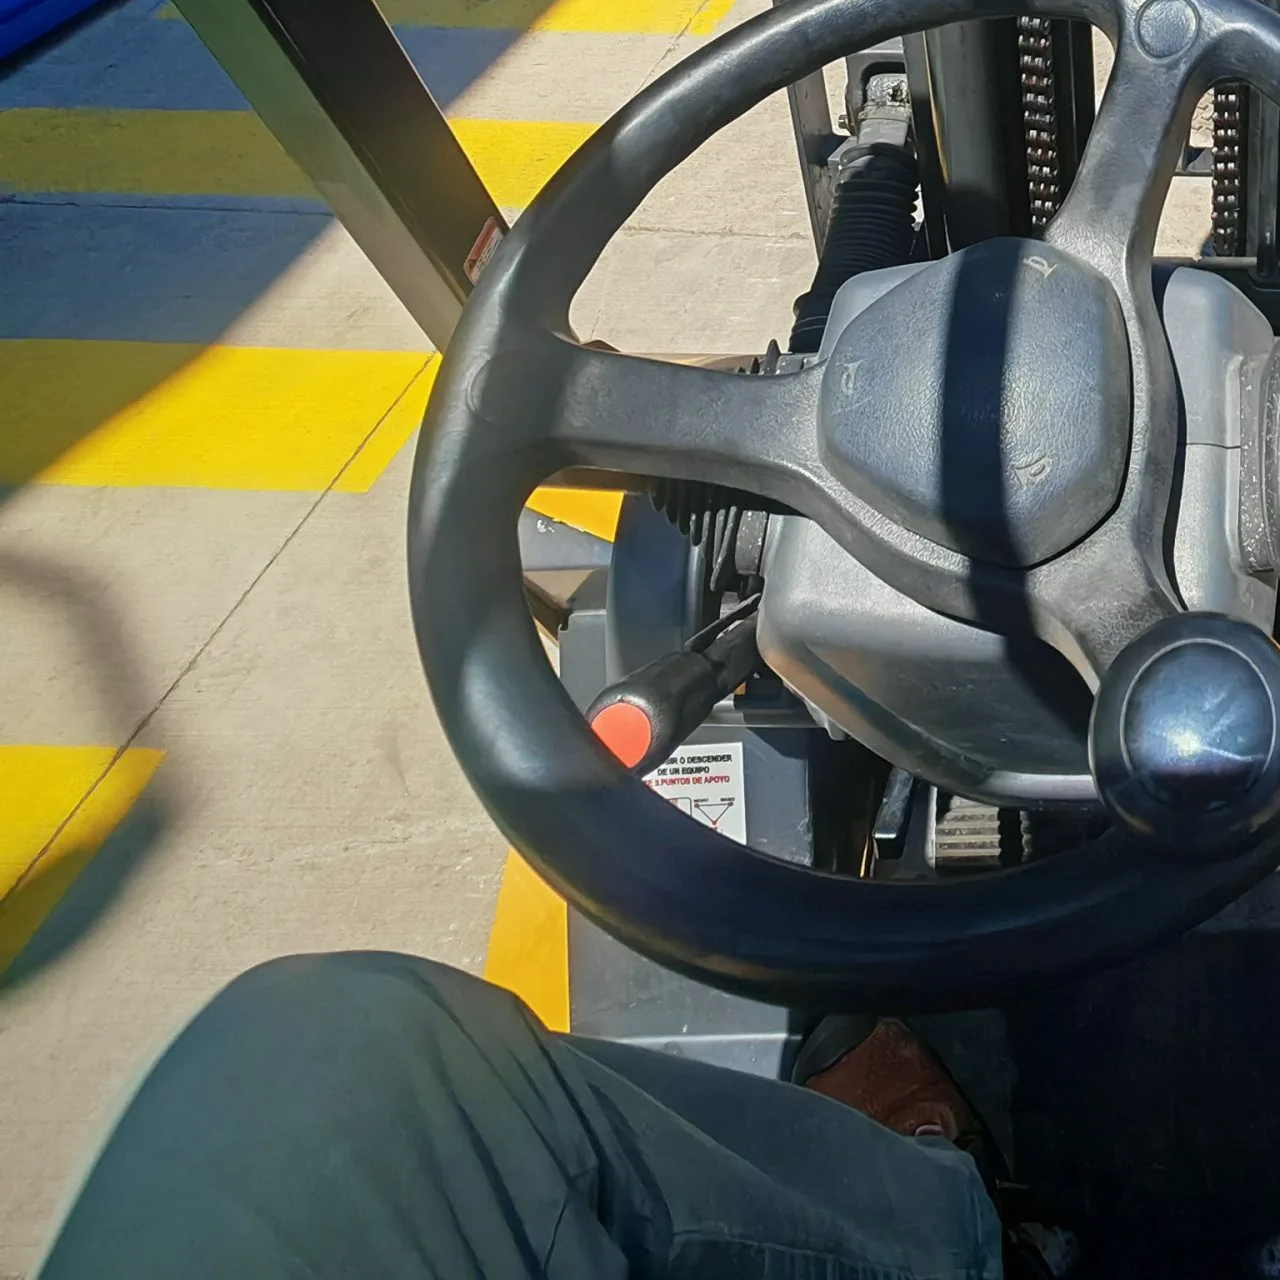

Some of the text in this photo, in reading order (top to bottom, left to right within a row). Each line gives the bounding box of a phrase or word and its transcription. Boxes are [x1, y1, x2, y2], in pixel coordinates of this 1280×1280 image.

[687, 754, 732, 764] DESCENDER
[657, 768, 668, 776] DE
[682, 766, 710, 775] EQUIPO
[692, 776, 703, 784] DE
[704, 775, 731, 784] APOYO
